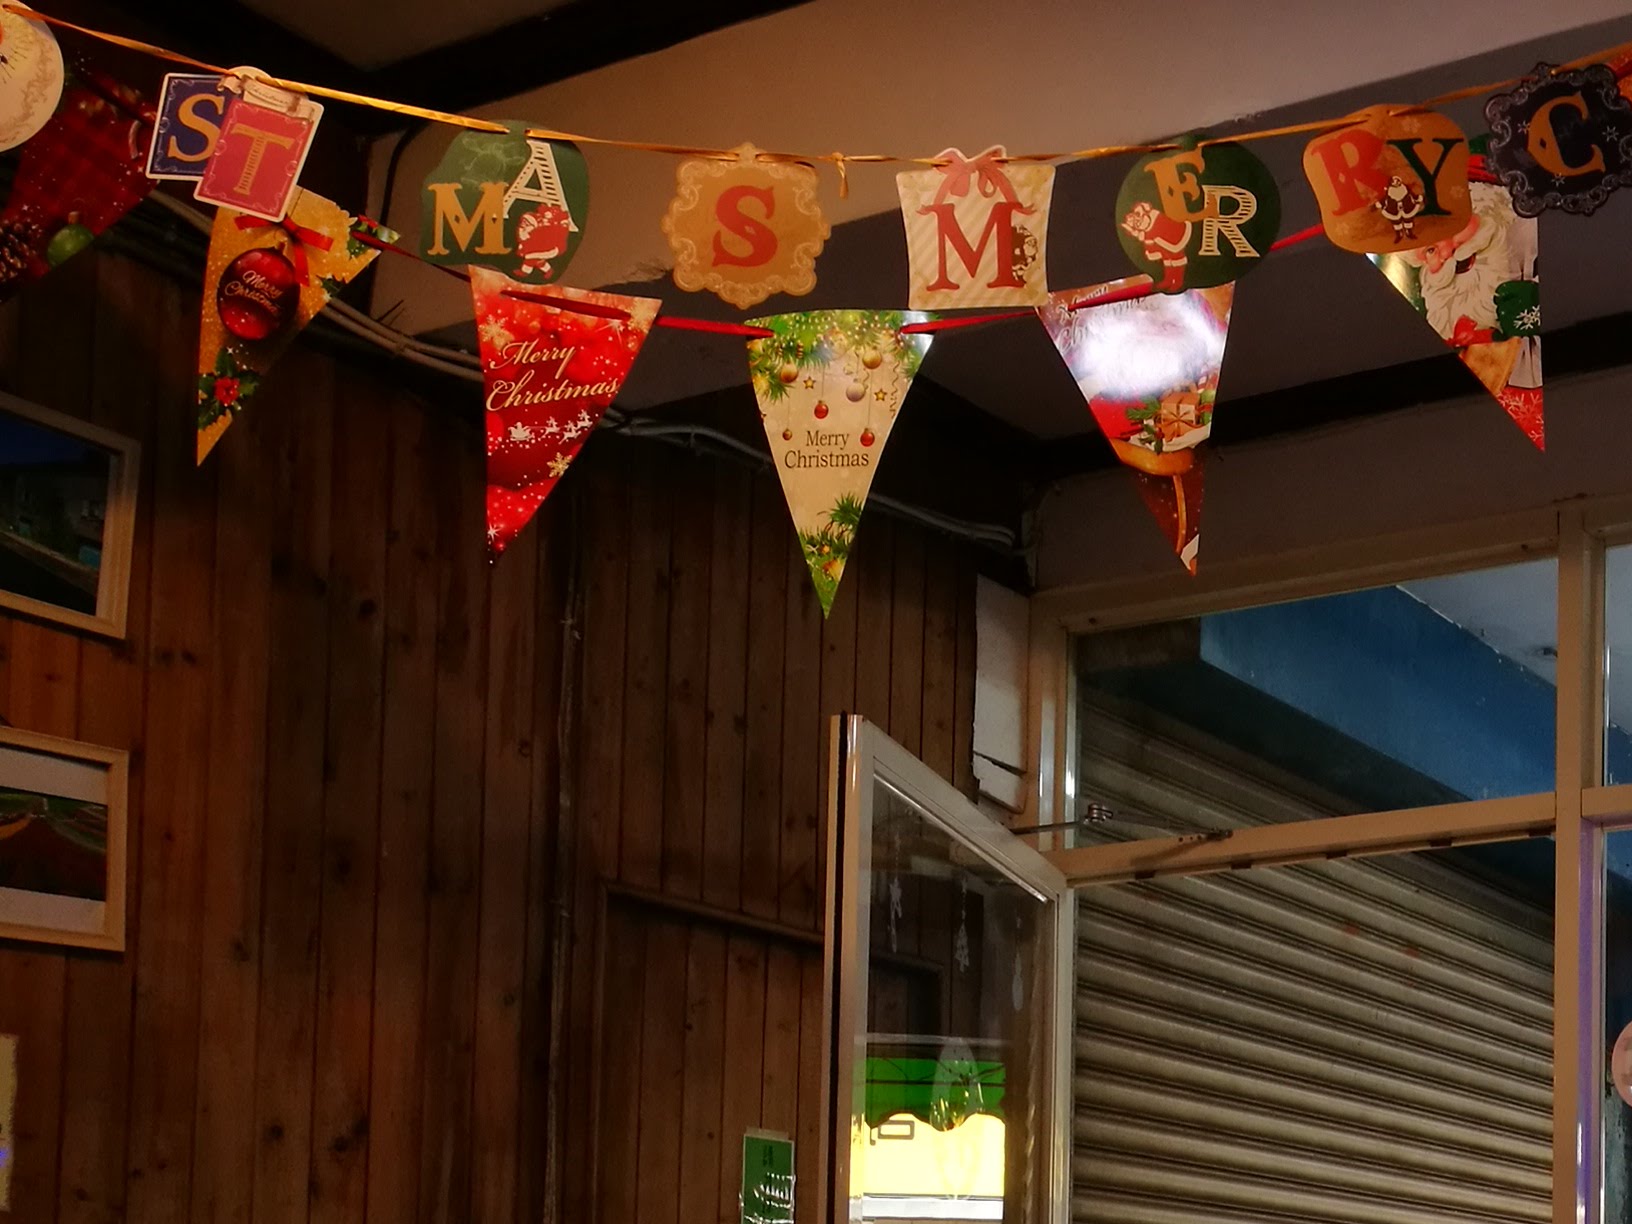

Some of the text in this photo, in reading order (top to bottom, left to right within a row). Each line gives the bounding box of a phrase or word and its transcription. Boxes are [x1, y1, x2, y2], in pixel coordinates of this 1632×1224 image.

[242, 270, 284, 300] Merry
[490, 338, 576, 379] Merry
[486, 370, 620, 412] Christmas
[806, 430, 850, 450] Merry
[784, 450, 870, 469] Christmas
